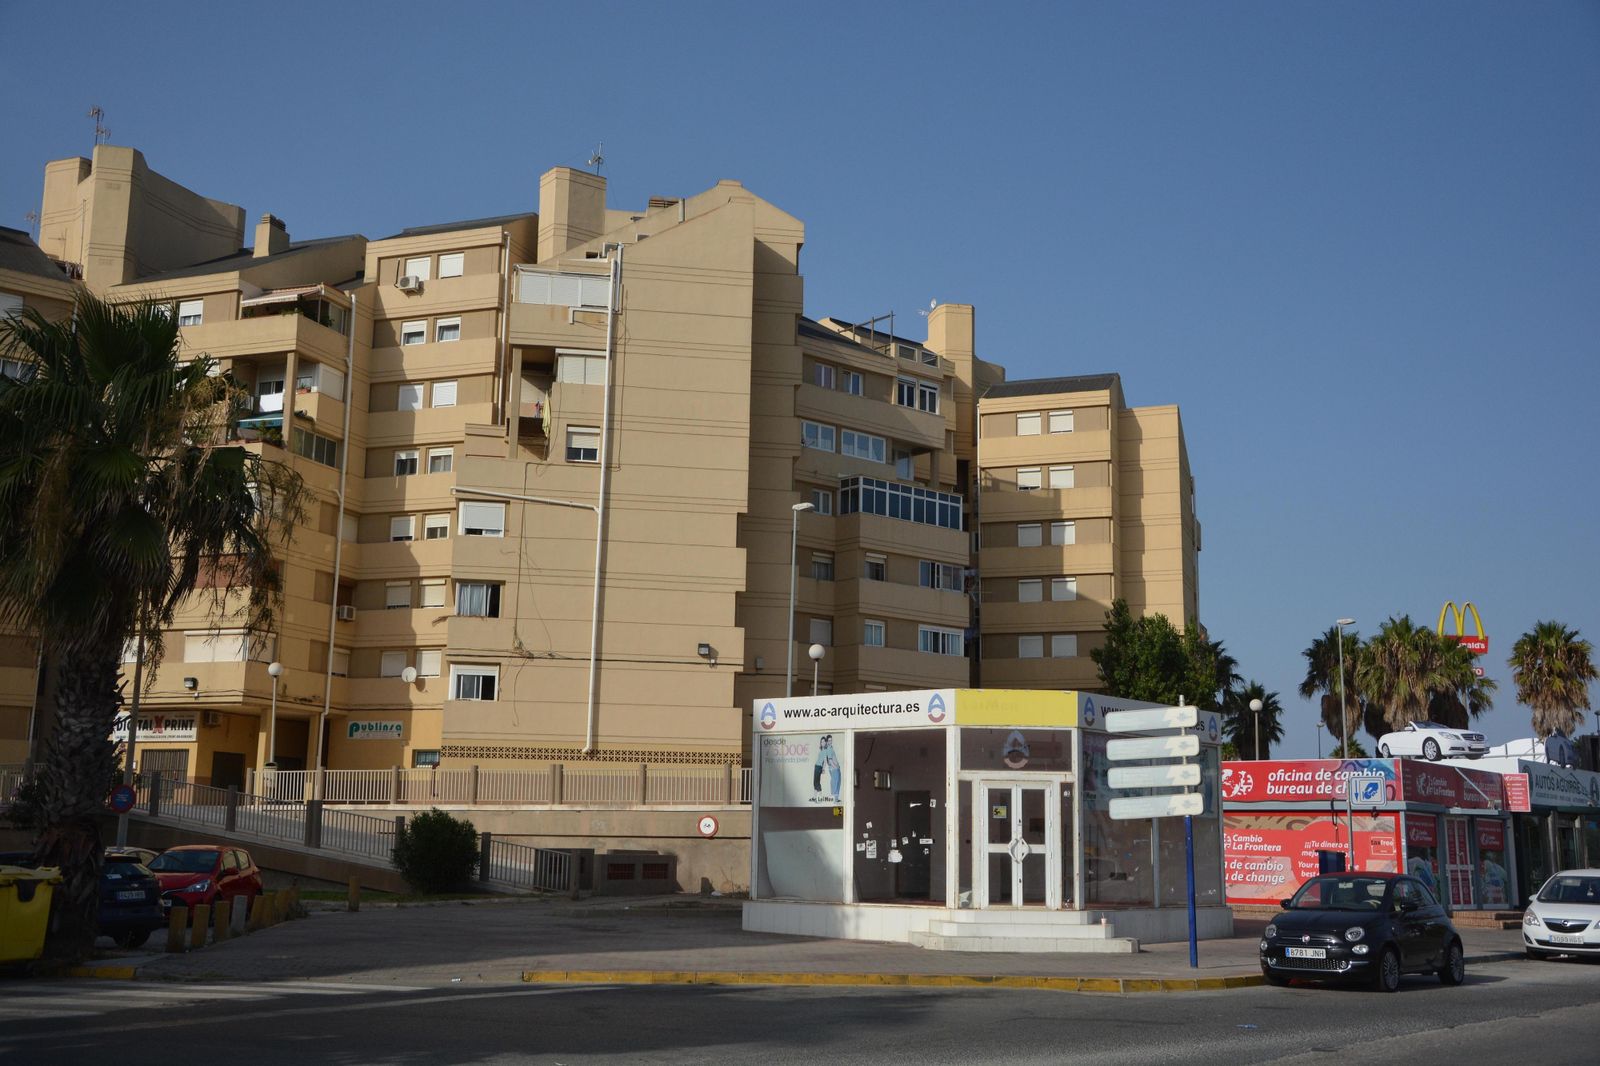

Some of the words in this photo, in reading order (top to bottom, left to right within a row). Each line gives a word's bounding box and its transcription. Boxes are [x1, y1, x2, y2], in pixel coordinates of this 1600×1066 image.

[783, 702, 920, 719] www.ac-arquitectura.es
[116, 719, 153, 732] DIGTAL
[164, 719, 195, 731] PRINT
[763, 737, 786, 746] desde
[1268, 769, 1312, 782] oficina
[1315, 768, 1333, 781] de
[1335, 768, 1385, 781] cambio
[1266, 782, 1313, 795] bureau
[1315, 782, 1333, 794] de
[1232, 833, 1263, 843] Cambio
[1232, 842, 1243, 850] La
[1244, 842, 1282, 851] Frontera
[1320, 840, 1343, 849] dinero
[1230, 859, 1244, 869] de
[1244, 860, 1284, 871] cambio
[1298, 860, 1314, 869] Your
[1231, 871, 1244, 881] de
[1246, 872, 1285, 885] change
[1301, 870, 1316, 878] best
[1290, 949, 1308, 957] 8781
[1311, 950, 1325, 958] JNH
